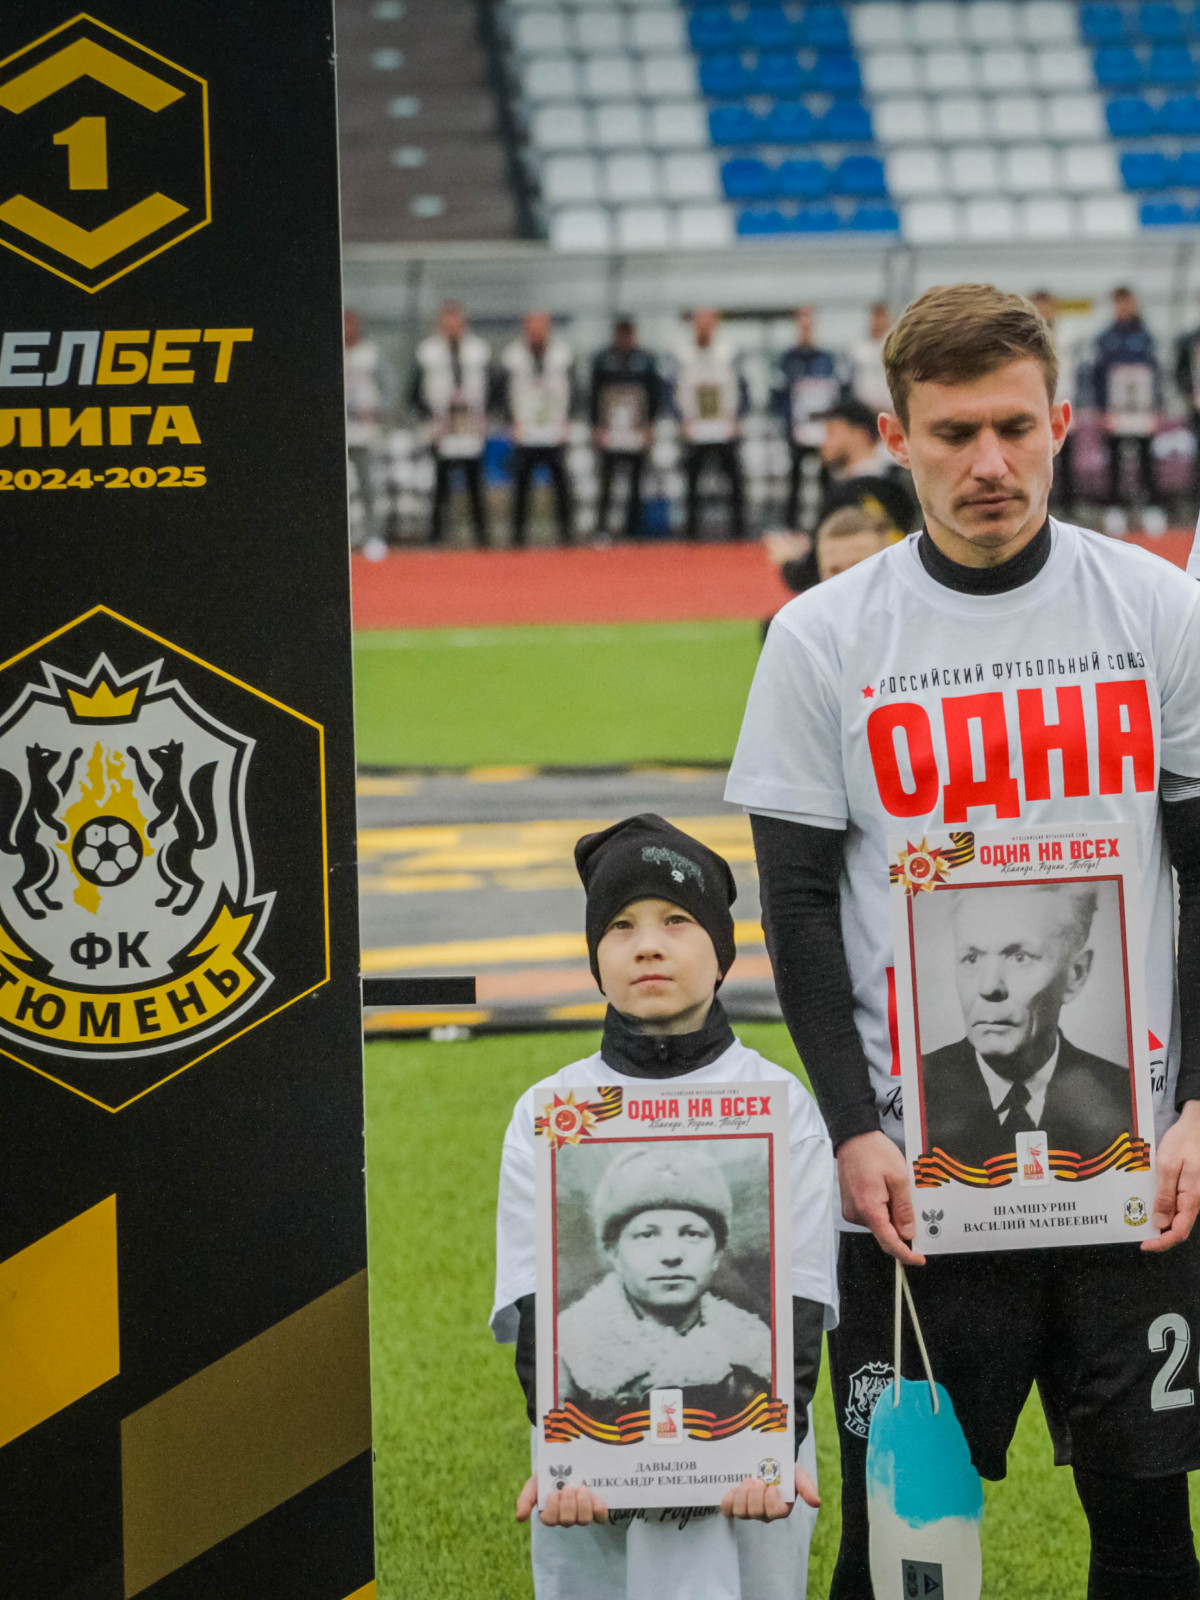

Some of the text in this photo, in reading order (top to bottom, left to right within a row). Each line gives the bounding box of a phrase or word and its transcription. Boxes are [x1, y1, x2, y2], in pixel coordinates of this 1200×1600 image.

[52, 116, 108, 190] 1
[0, 328, 254, 387] ЕЛБЕТ
[0, 405, 201, 448] ЛИГА
[0, 466, 207, 490] 2024-2025
[880, 664, 984, 694] РОССИЙСКИЙ
[993, 652, 1101, 680] ФУТБОЛЬНЫЙ
[867, 679, 1154, 823] ОДНА
[980, 838, 1120, 867] ОДНА НА ВСЕХ
[70, 931, 152, 970] ФК
[628, 1096, 771, 1121] ОДНА НА ВСЕХ
[993, 1201, 1076, 1216] ШАМШУРИН
[964, 1217, 1026, 1233] ВАСИЛИЙ
[1029, 1214, 1108, 1230] МАТВЕЕВИЧ
[635, 1461, 697, 1473] ДАВЫДОВ
[581, 1477, 655, 1489] АЛЕКСАНДР
